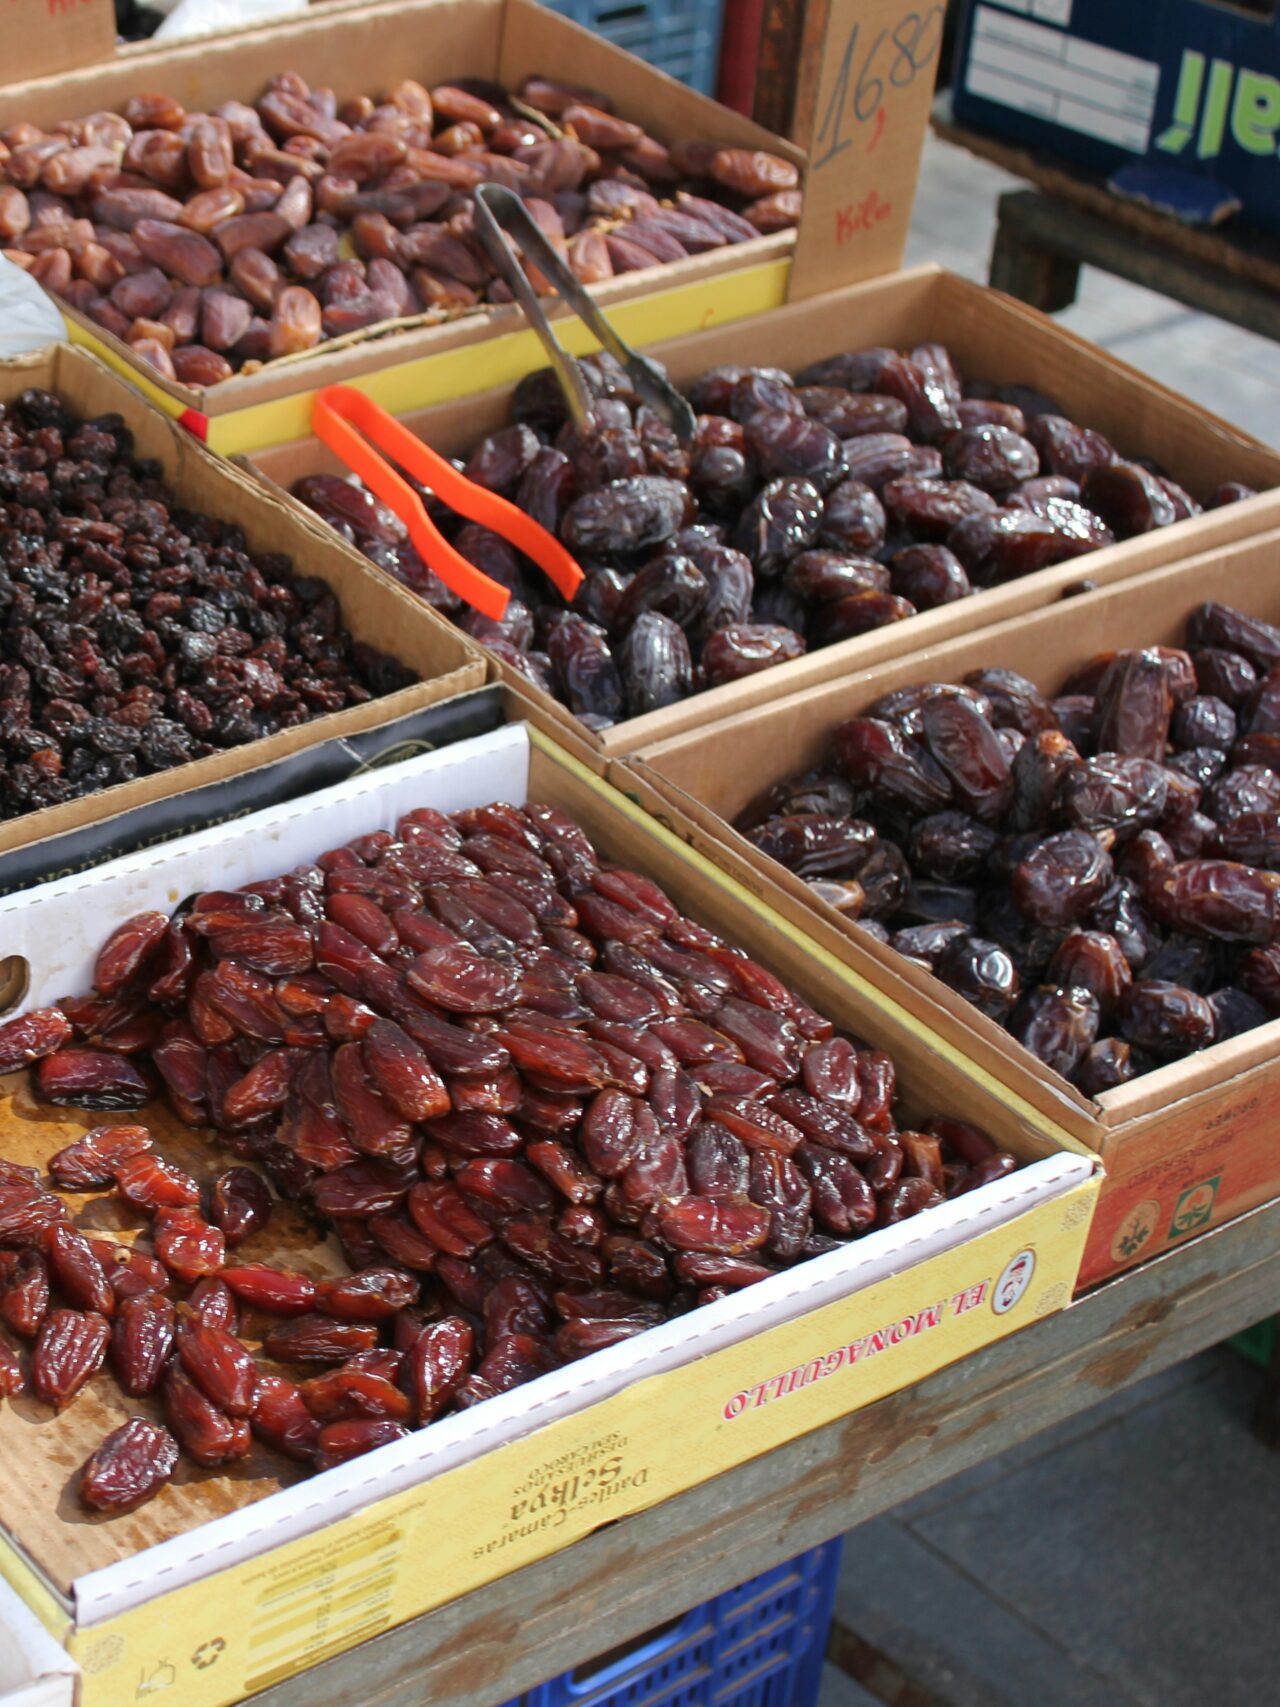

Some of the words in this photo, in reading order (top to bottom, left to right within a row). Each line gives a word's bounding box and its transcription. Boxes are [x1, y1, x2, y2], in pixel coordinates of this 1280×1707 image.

[835, 190, 892, 246] Kilo
[951, 1278, 992, 1318] EL
[721, 1299, 948, 1421] MONAGUILLO
